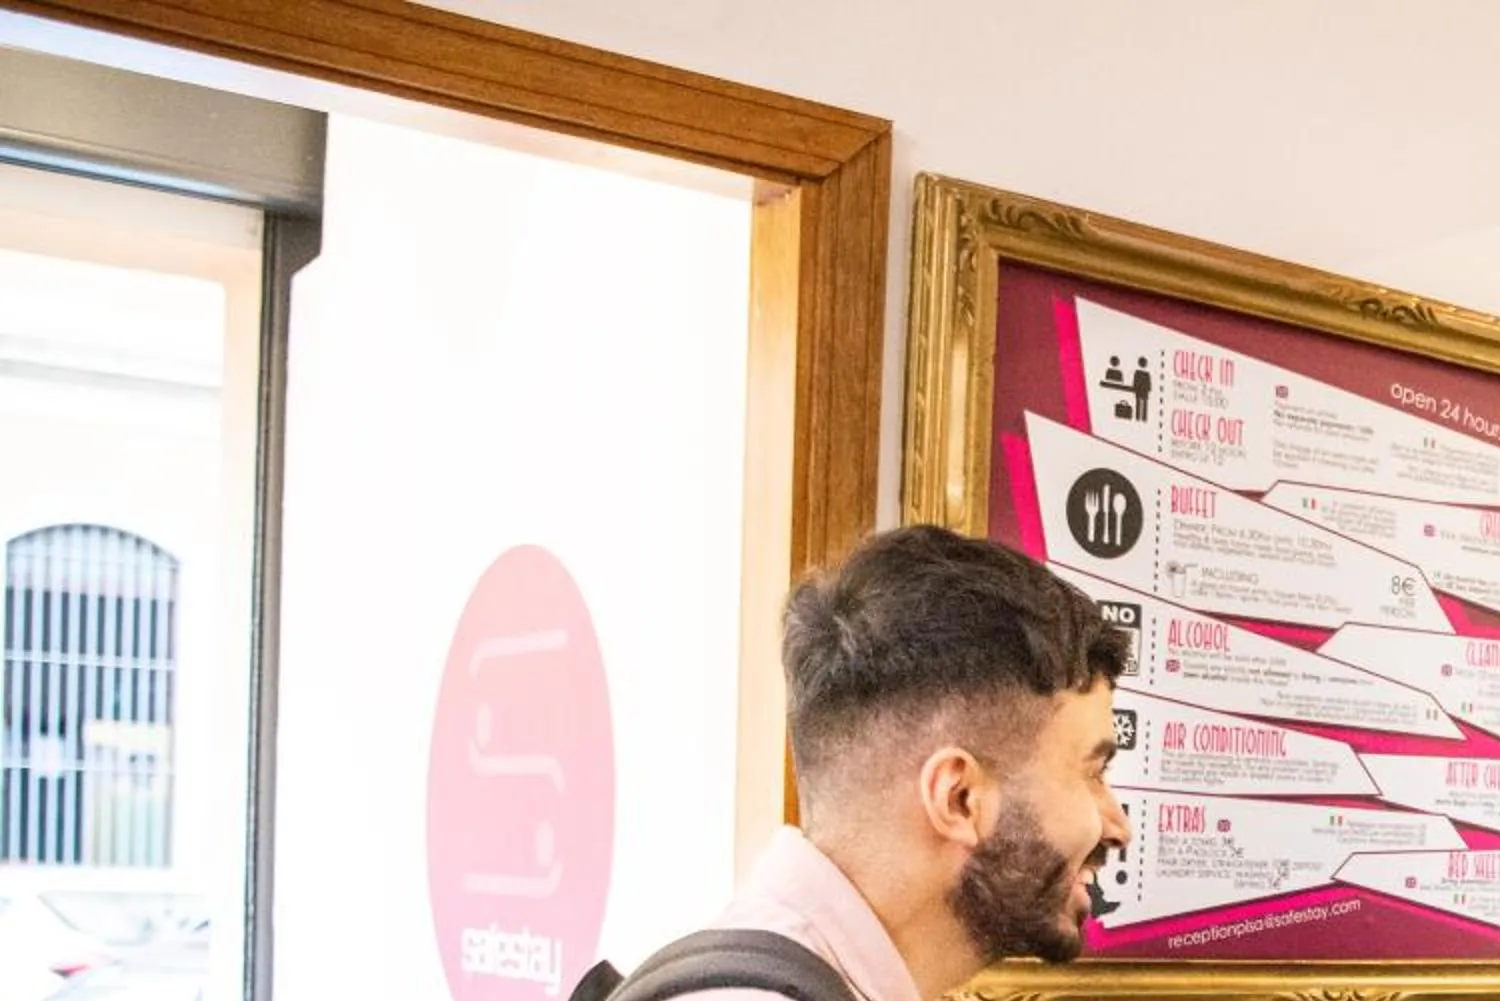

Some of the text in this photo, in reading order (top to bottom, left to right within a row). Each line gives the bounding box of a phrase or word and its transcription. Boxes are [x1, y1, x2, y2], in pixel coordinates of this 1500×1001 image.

[1173, 349, 1235, 388] CHECK IN
[1390, 383, 1437, 416] open
[1440, 399, 1461, 423] 24
[1171, 408, 1211, 442] CHECK
[1217, 416, 1245, 447] OUT
[1170, 485, 1216, 519] BUFFET
[1101, 604, 1136, 623] NO
[1168, 619, 1231, 652] ALCOHOL
[1163, 721, 1287, 757] AIR CONDITIONING
[1445, 761, 1478, 788] AFTER
[1158, 803, 1207, 833] EXTRAS
